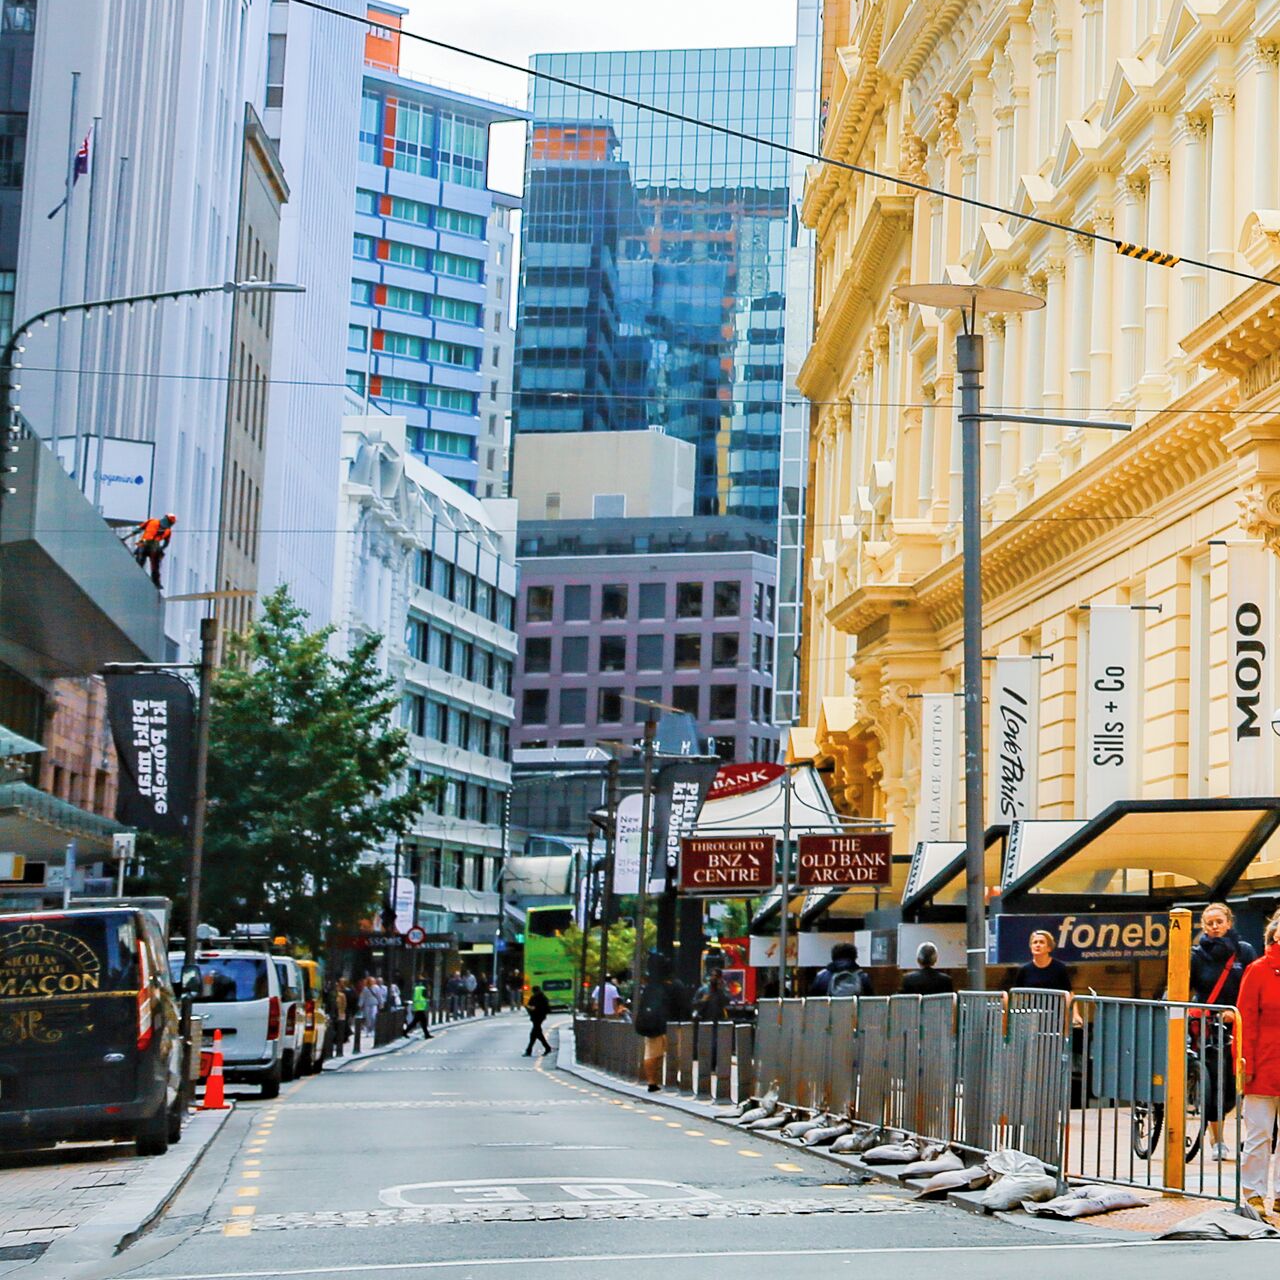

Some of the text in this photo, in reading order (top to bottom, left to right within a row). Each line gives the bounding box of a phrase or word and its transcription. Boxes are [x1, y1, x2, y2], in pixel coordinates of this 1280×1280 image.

[1094, 665, 1126, 692] Co
[1235, 601, 1267, 742] MOJO
[1094, 721, 1125, 767] Sills
[930, 703, 943, 842] ALLACE COTTON
[692, 841, 765, 852] THROUGH TO
[828, 838, 861, 852] THE
[708, 854, 742, 868] BNZ
[801, 853, 836, 867] OLD
[840, 852, 887, 866] BANK
[693, 869, 760, 883] CENTRE
[810, 867, 879, 882] ARCADE
